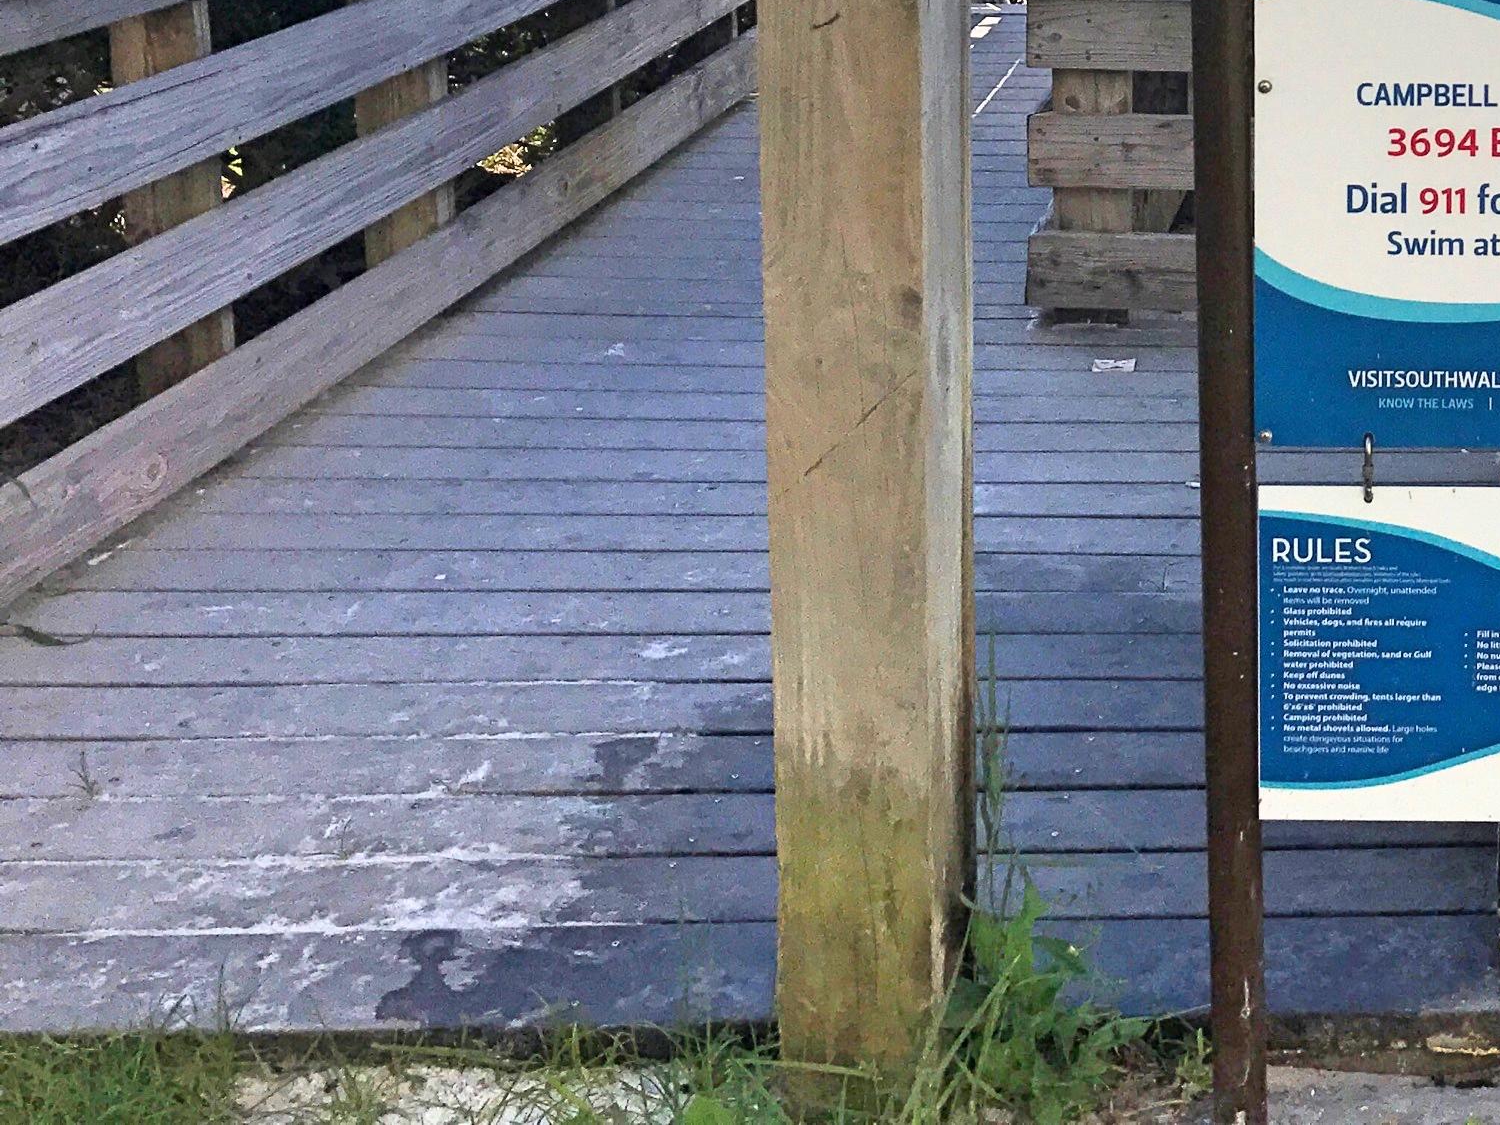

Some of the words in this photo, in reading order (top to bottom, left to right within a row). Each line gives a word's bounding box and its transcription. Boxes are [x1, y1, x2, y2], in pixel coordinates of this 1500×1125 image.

[1356, 83, 1497, 107] CAMPBELL
[1387, 128, 1478, 157] 3694
[1346, 183, 1407, 214] Dial
[1419, 187, 1466, 215] 911
[1387, 231, 1464, 256] Swim
[1474, 235, 1500, 257] at
[1379, 398, 1414, 408] KNOW
[1417, 399, 1438, 409] THE
[1441, 399, 1474, 409] LAWS
[1272, 538, 1372, 563] RULES
[1347, 587, 1389, 595] Overnight,
[1307, 608, 1352, 616] prohibited
[1283, 619, 1320, 627] Vehicles,
[1396, 619, 1427, 627] require
[1283, 629, 1316, 638] permits
[1333, 640, 1377, 649] prohibited
[1332, 651, 1380, 659] vegetation,
[1309, 661, 1353, 670] prohibited
[1283, 672, 1304, 680] Keep
[1477, 684, 1497, 693] edge
[1295, 694, 1328, 702] prevent
[1329, 694, 1370, 702] crowding,
[1395, 694, 1420, 703] larger
[1318, 704, 1362, 713] prohibited
[1283, 714, 1321, 723] Camping
[1323, 714, 1367, 723] prohibited
